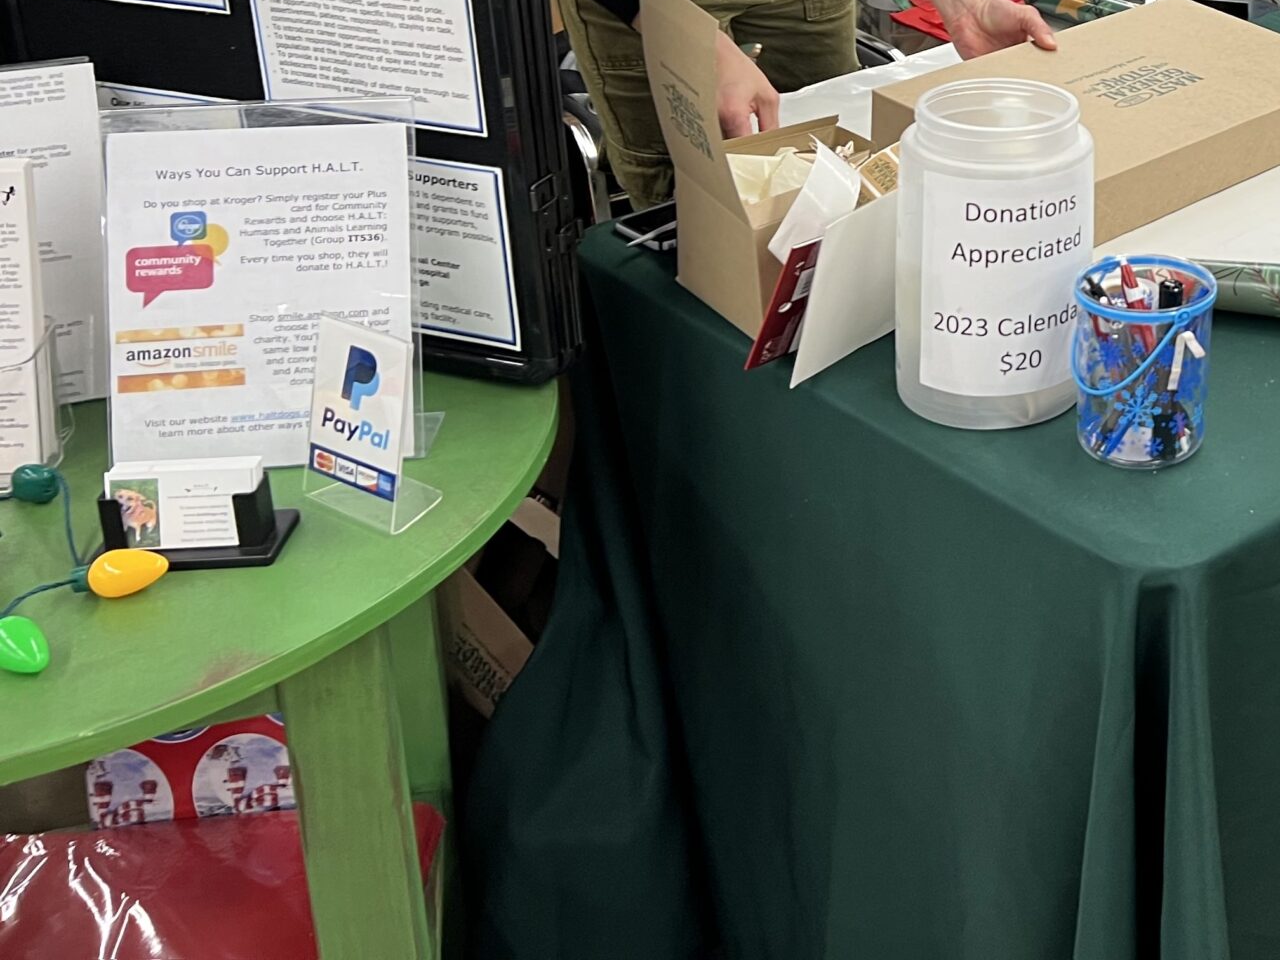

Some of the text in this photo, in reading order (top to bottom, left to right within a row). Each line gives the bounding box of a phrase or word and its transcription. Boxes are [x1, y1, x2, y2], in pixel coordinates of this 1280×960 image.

[1096, 68, 1185, 101] GENERAL
[1099, 65, 1157, 90] STORE
[1151, 70, 1205, 97] MAST
[155, 161, 362, 181] Ways You Can Support H.A.L.T.
[143, 189, 387, 209] Do you shop at Kroger? Simply register your Plus
[289, 201, 387, 212] card for Community
[965, 194, 1077, 224] Donations
[288, 214, 308, 223] and
[310, 214, 345, 222] choose
[238, 223, 387, 236] Humans and Animals Learning
[263, 238, 307, 247] Together
[310, 235, 345, 245] (Group
[951, 225, 1082, 268] Appreciated
[134, 254, 201, 269] community
[239, 248, 388, 264] Every time you shop, they will
[134, 265, 182, 277] rewards
[295, 263, 329, 272] donate
[332, 262, 343, 270] to
[418, 268, 450, 278] ospital
[248, 313, 274, 322] Shop
[371, 306, 389, 316] and
[933, 302, 1078, 338] 2023 Calenda
[273, 323, 308, 332] choose
[126, 341, 237, 362] amazonsmile
[261, 344, 309, 354] same low
[265, 355, 317, 365] and conve
[999, 349, 1042, 376] $20
[271, 367, 291, 375] and
[143, 418, 166, 428] Visit
[168, 418, 186, 426] our
[188, 415, 228, 424] website
[322, 407, 390, 451] PayPal
[157, 421, 303, 438] learn more about other ways
[338, 463, 355, 476] VISA
